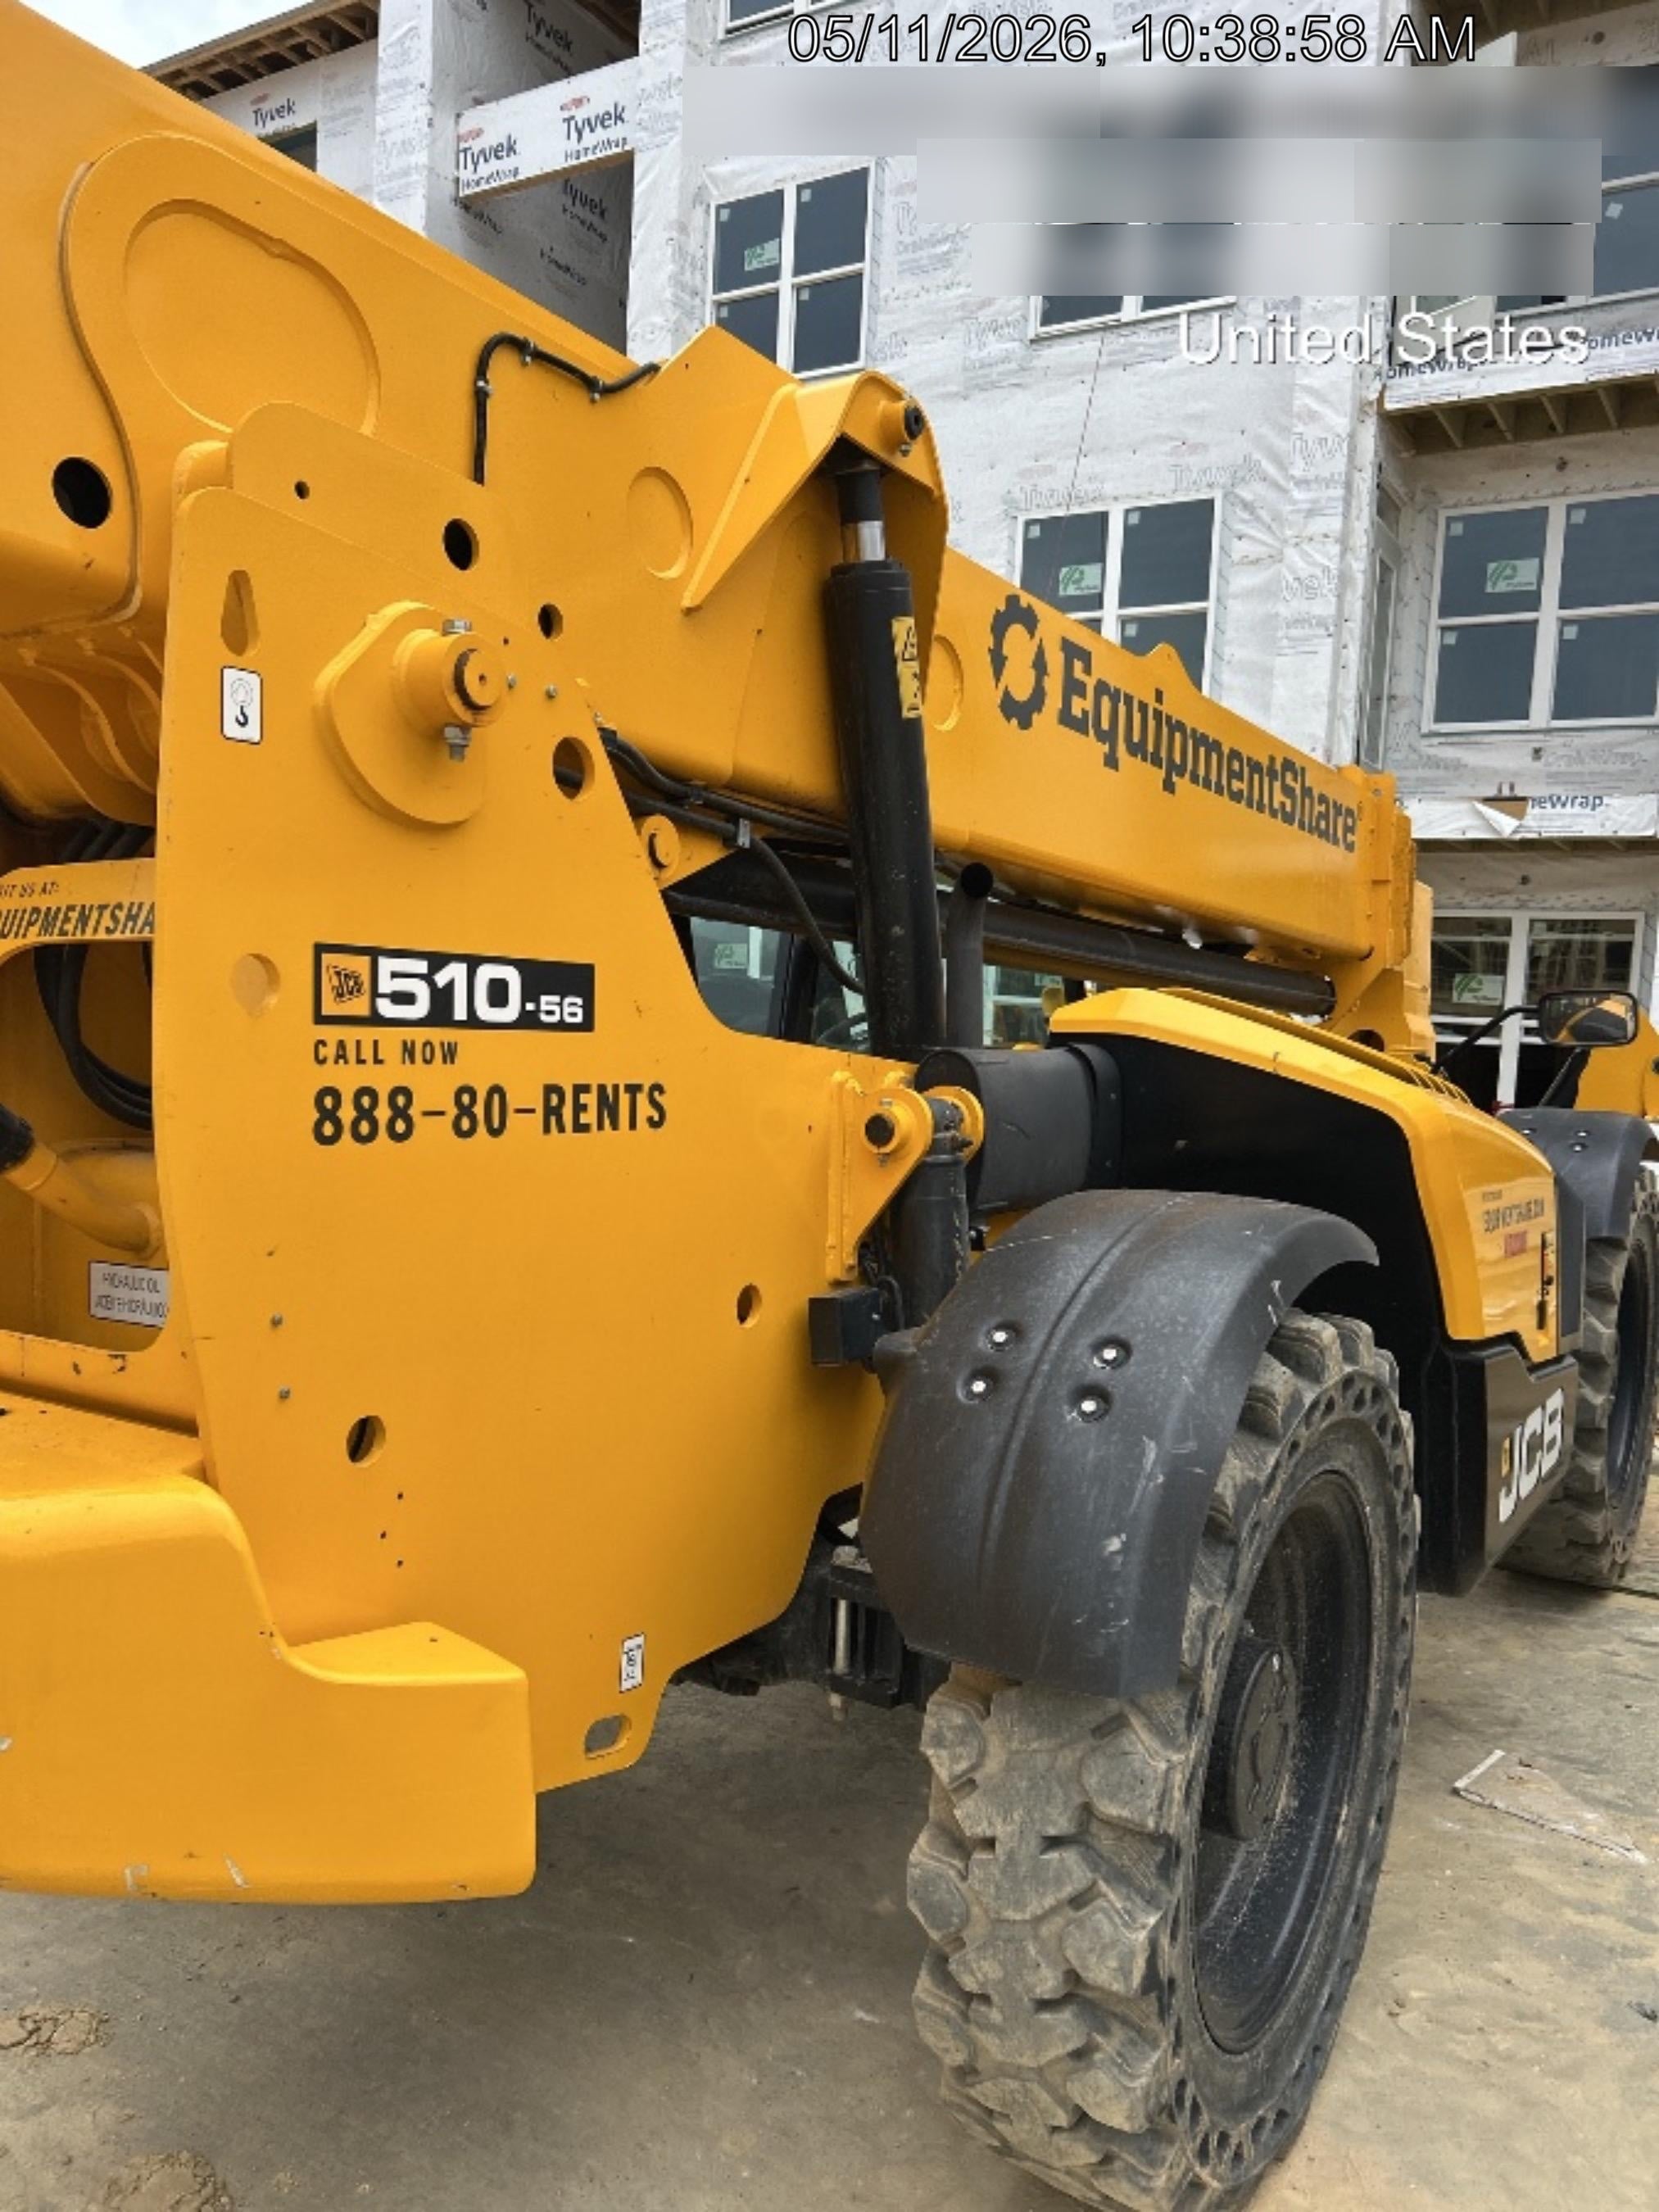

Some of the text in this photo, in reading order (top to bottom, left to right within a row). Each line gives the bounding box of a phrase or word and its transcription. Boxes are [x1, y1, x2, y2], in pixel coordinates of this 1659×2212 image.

[252, 97, 296, 128] Tyvek
[562, 102, 626, 144] Tyvek
[460, 134, 518, 174] Tyvek
[1057, 635, 1357, 854] EquipmentShare
[313, 1039, 459, 1065] CALL NOW
[311, 1082, 668, 1146] 888-80-RENTS
[1498, 1388, 1565, 1523] JCB
